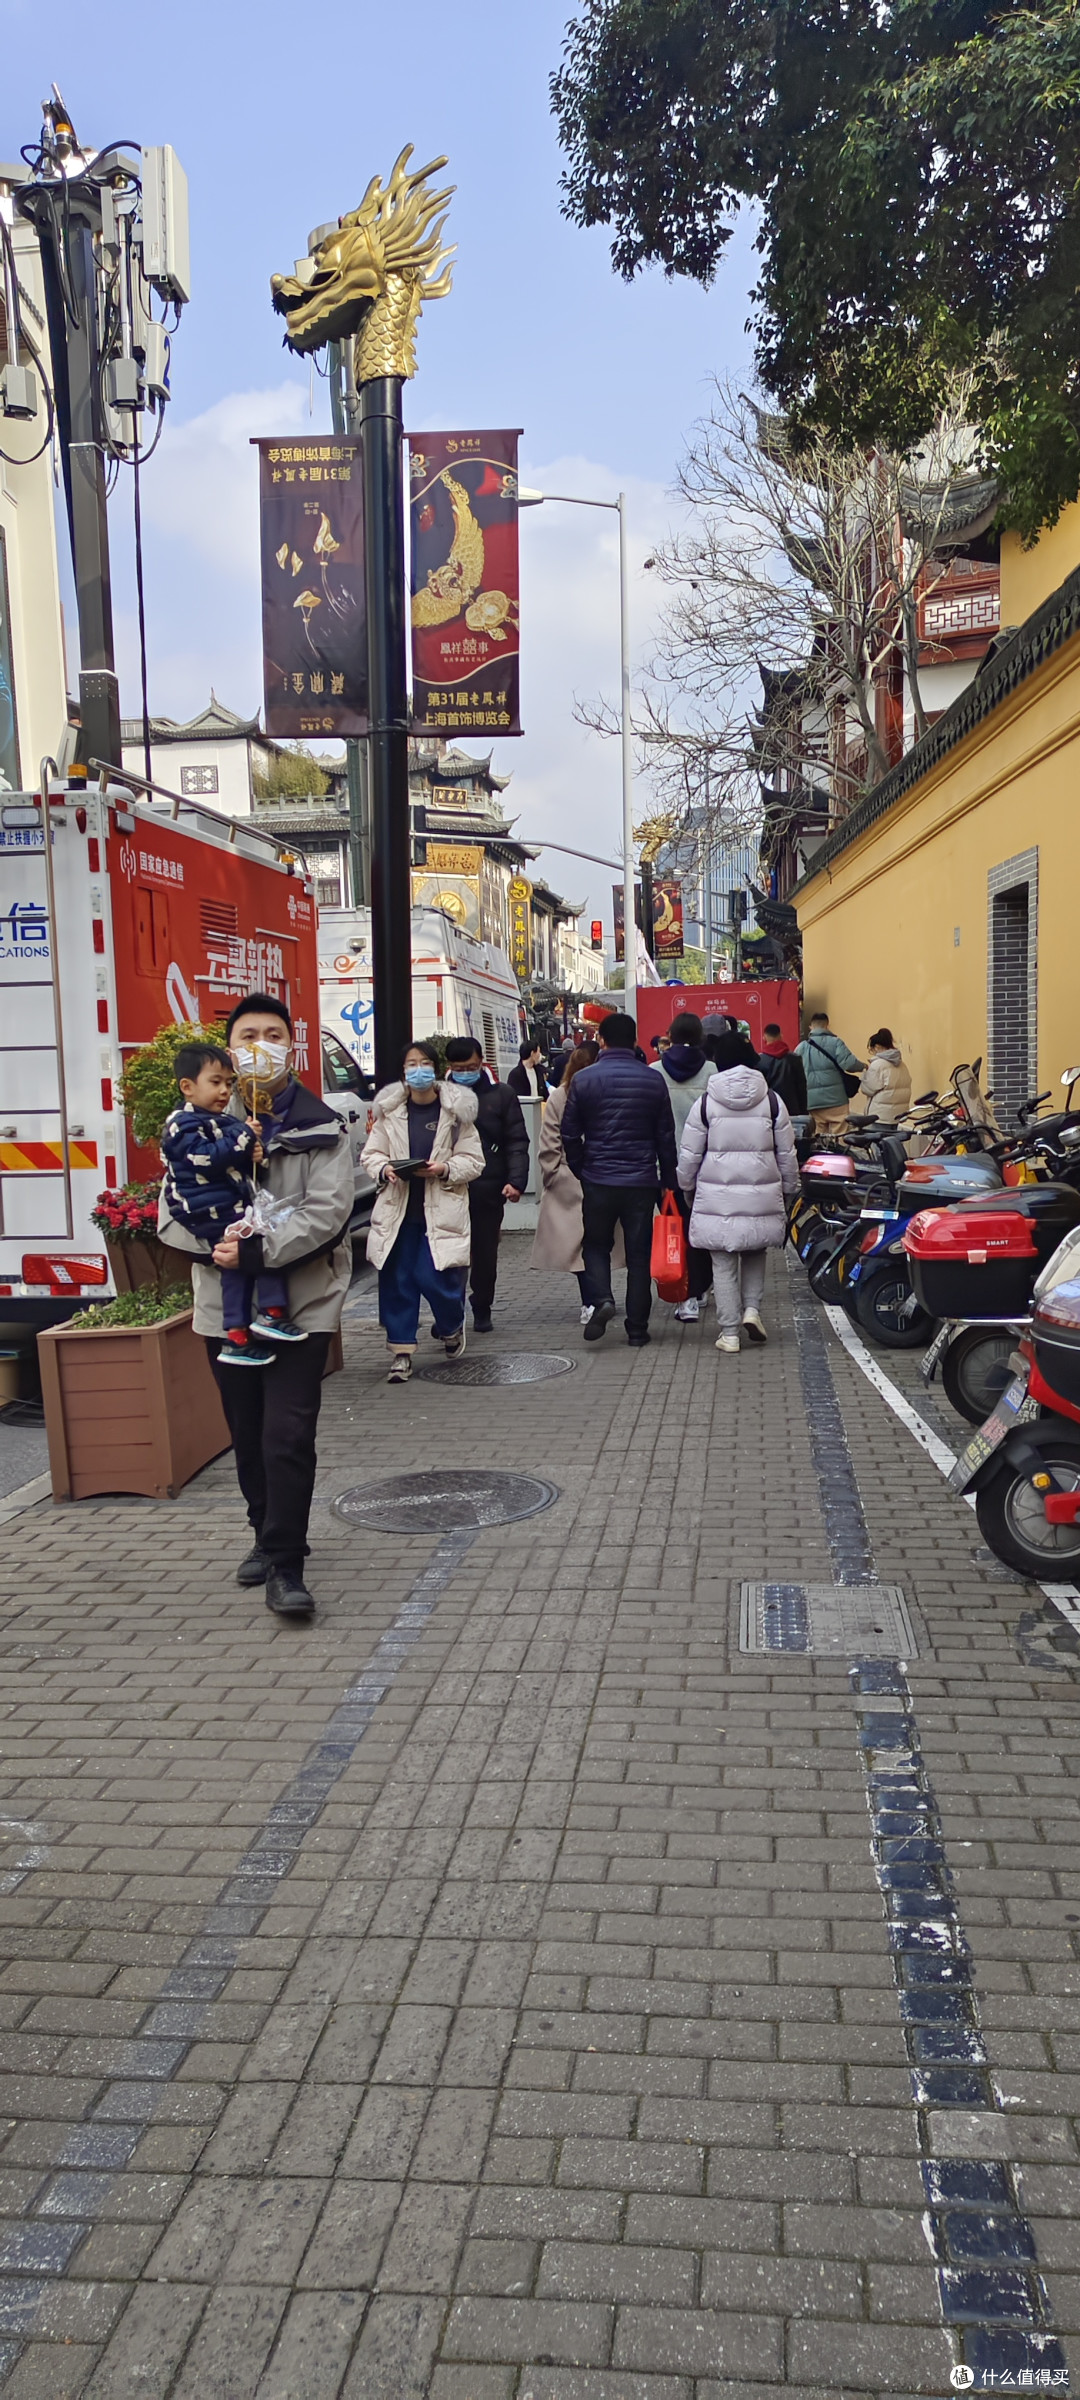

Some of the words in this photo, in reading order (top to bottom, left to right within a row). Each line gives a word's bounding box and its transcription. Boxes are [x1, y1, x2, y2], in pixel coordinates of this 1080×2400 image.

[421, 711, 511, 727] 上海首饰博览会
[140, 851, 184, 882] 国家应急通信
[986, 1239, 1009, 1247] SMART
